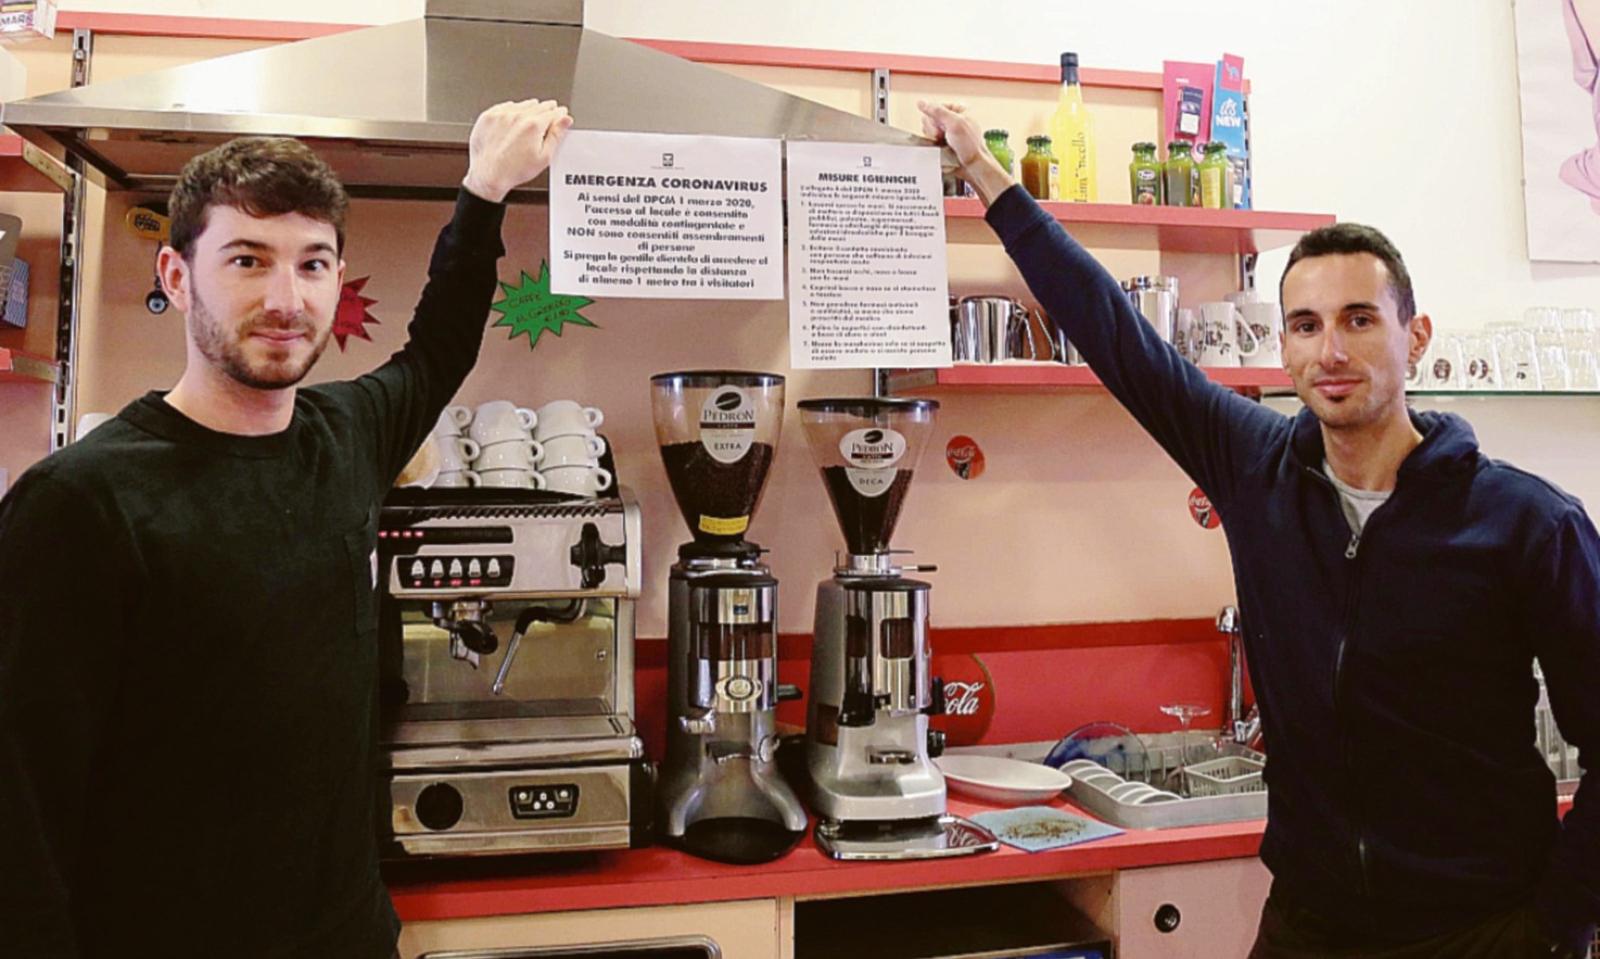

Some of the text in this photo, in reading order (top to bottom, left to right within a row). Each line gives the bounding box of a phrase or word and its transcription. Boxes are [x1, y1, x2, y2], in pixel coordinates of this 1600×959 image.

[1216, 114, 1242, 128] NEW
[565, 174, 768, 192] EMERGENZA CORONAVIRUS
[818, 172, 917, 184] MISURE IGIENICHE
[578, 192, 589, 202] Ai
[593, 193, 620, 202] sensi
[623, 194, 640, 204] del
[644, 195, 675, 205] DPCM
[688, 198, 722, 207] marzo
[635, 206, 646, 216] al
[650, 206, 681, 216] locale
[694, 208, 748, 218] consentito
[588, 218, 606, 226] con
[567, 227, 764, 242] NON sono consentiti assembramenti
[638, 242, 695, 254] di persone
[563, 250, 573, 260] Si
[574, 252, 606, 262] prega
[620, 252, 654, 264] gentile
[656, 254, 698, 264] clientela
[700, 254, 710, 264] di
[586, 263, 746, 276] locale rispettando la distanza
[578, 274, 589, 284] di
[592, 276, 632, 285] almeno
[646, 278, 678, 286] metro
[682, 278, 697, 286] tra
[707, 278, 754, 288] visitatori
[704, 408, 754, 421] PEDRON
[714, 442, 742, 451] EXTRA
